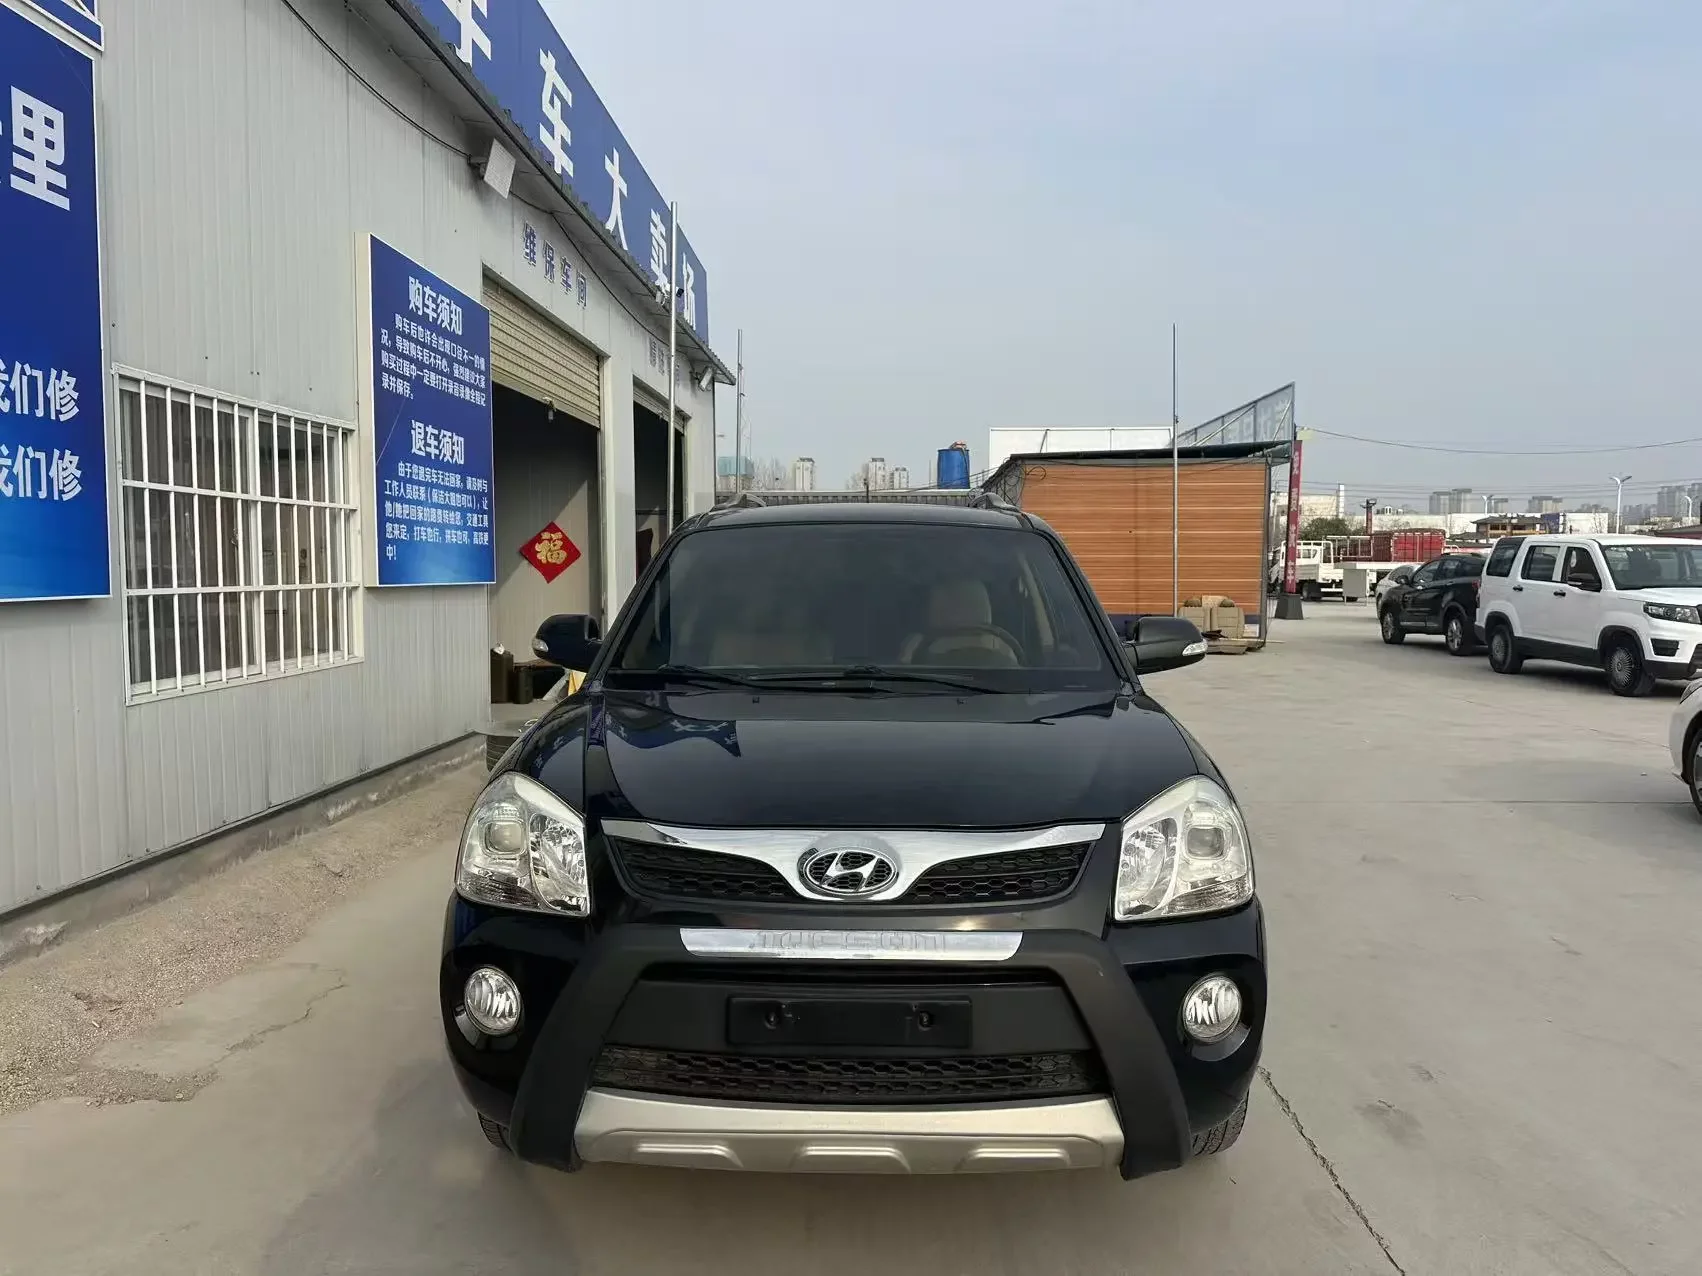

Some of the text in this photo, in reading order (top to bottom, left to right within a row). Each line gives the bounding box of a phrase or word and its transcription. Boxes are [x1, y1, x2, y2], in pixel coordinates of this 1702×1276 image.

[0, 85, 70, 210] 里
[524, 222, 586, 309] 维保车间
[408, 275, 463, 336] 购车须知
[411, 419, 465, 465] 退车须知
[535, 532, 567, 564] 福
